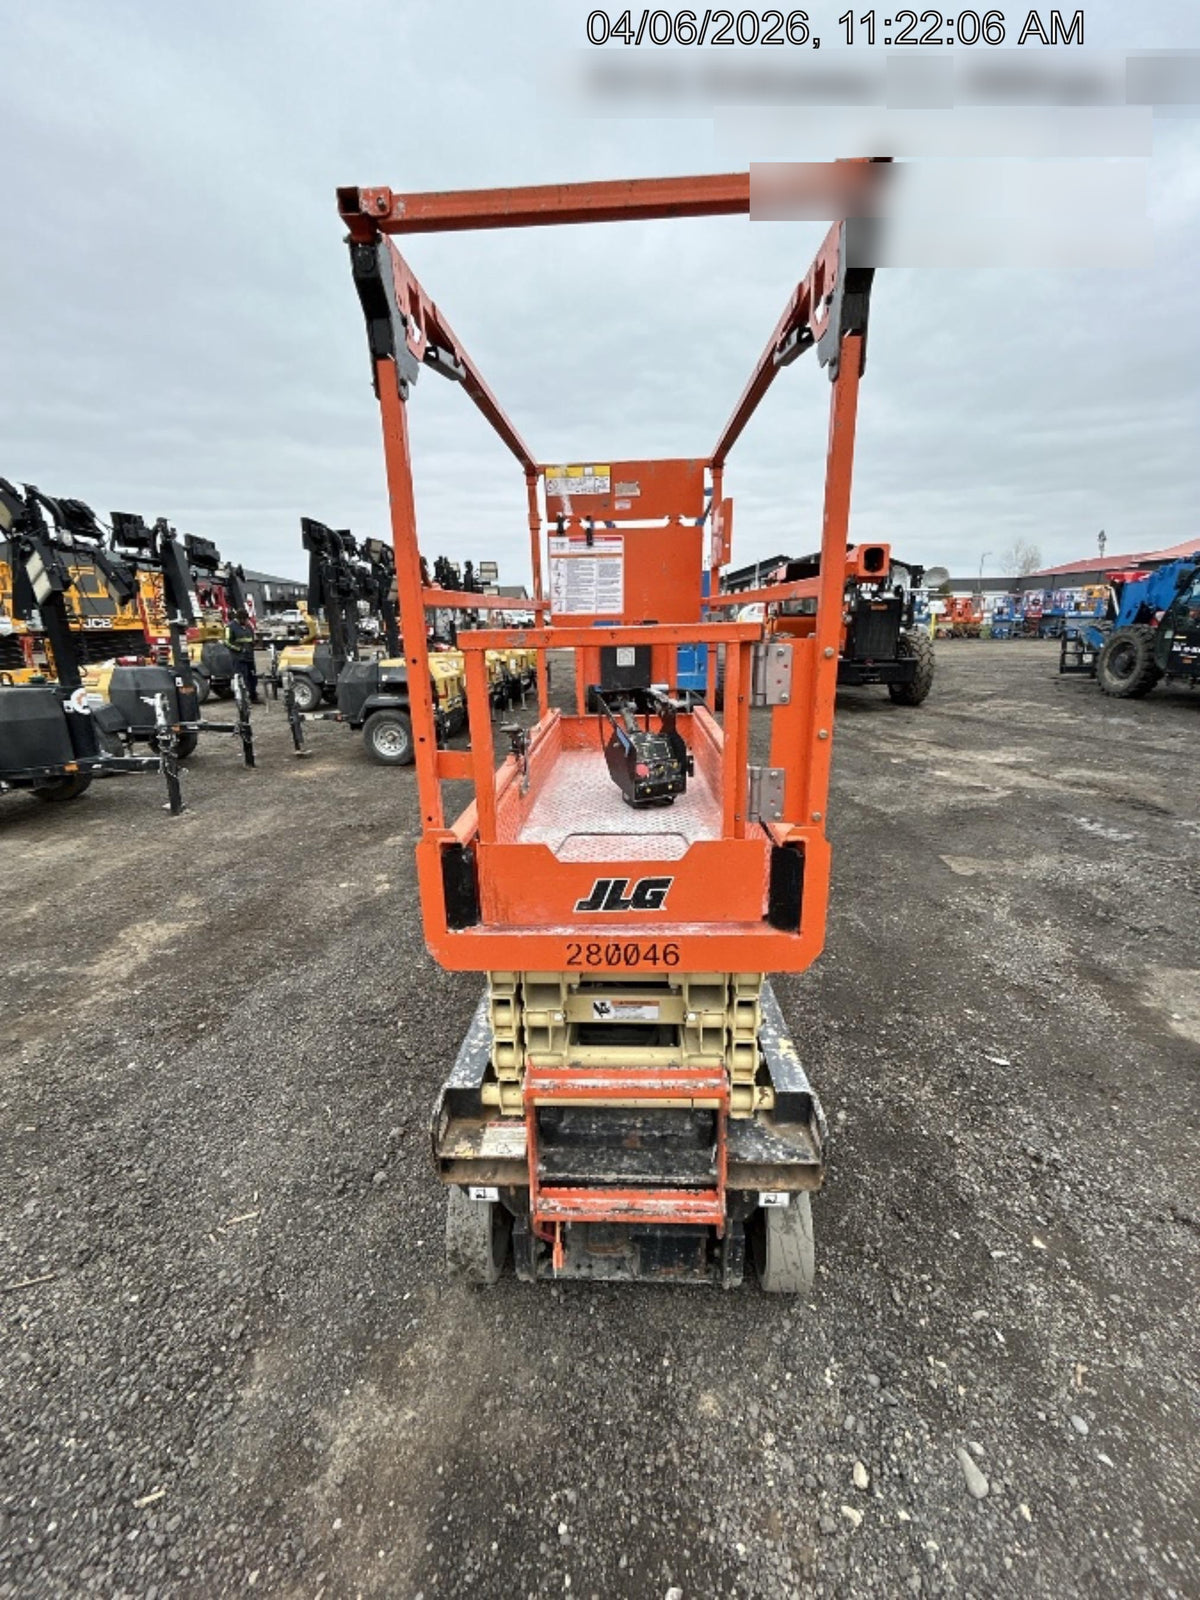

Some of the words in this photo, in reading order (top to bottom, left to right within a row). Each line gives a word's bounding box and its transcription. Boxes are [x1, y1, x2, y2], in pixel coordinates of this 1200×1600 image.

[83, 618, 112, 629] JCB
[573, 876, 674, 912] JLG
[566, 943, 680, 966] 280046
